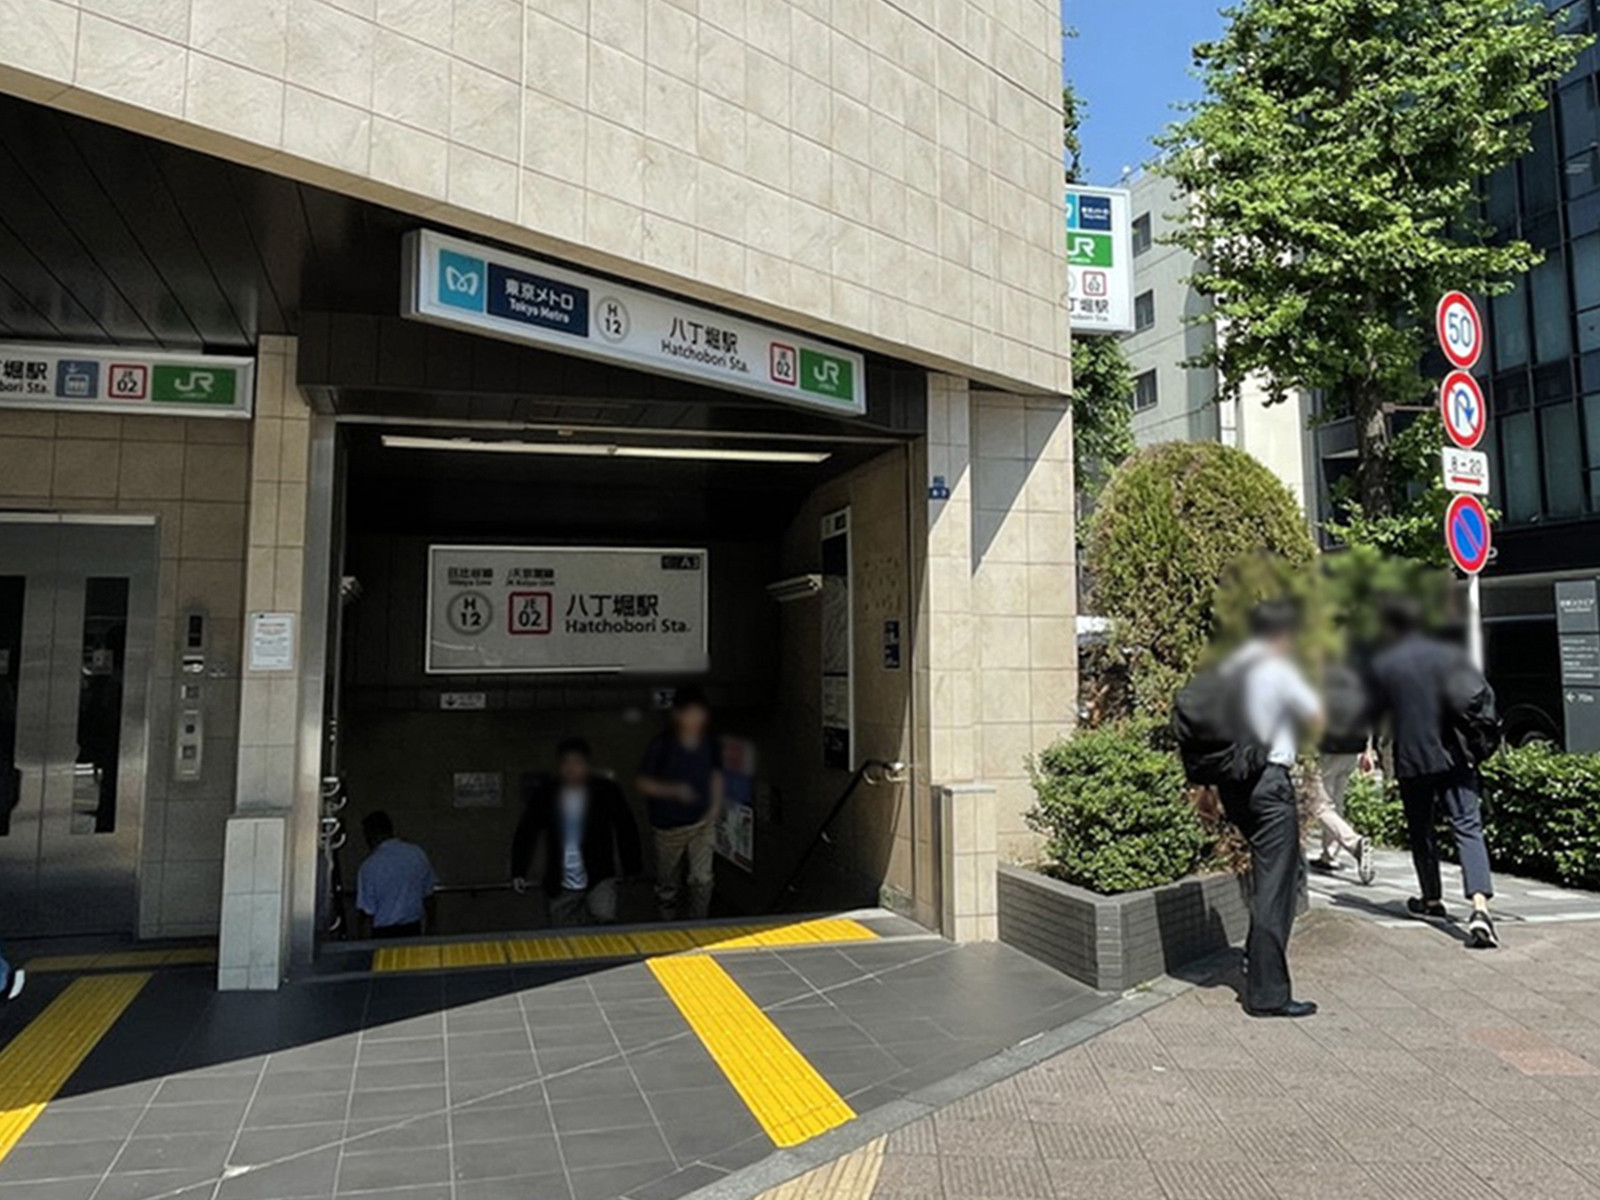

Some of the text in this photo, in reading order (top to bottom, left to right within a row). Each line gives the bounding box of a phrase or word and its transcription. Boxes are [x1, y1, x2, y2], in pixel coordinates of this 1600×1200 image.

[505, 278, 574, 310] 東京メトロ
[608, 303, 618, 317] H
[605, 317, 622, 335] 12
[1448, 312, 1472, 348] 50
[670, 317, 738, 355] 八丁堀駅
[661, 339, 727, 366] Hatchobori
[776, 360, 790, 378] 02
[813, 360, 839, 385] JR
[117, 379, 138, 392] 02
[174, 371, 214, 393] JR
[464, 597, 476, 610] H
[566, 594, 659, 617] 八丁堀駅
[461, 611, 481, 627] 12
[519, 610, 542, 627] 02
[565, 618, 692, 633] Hatchobori Sta.
